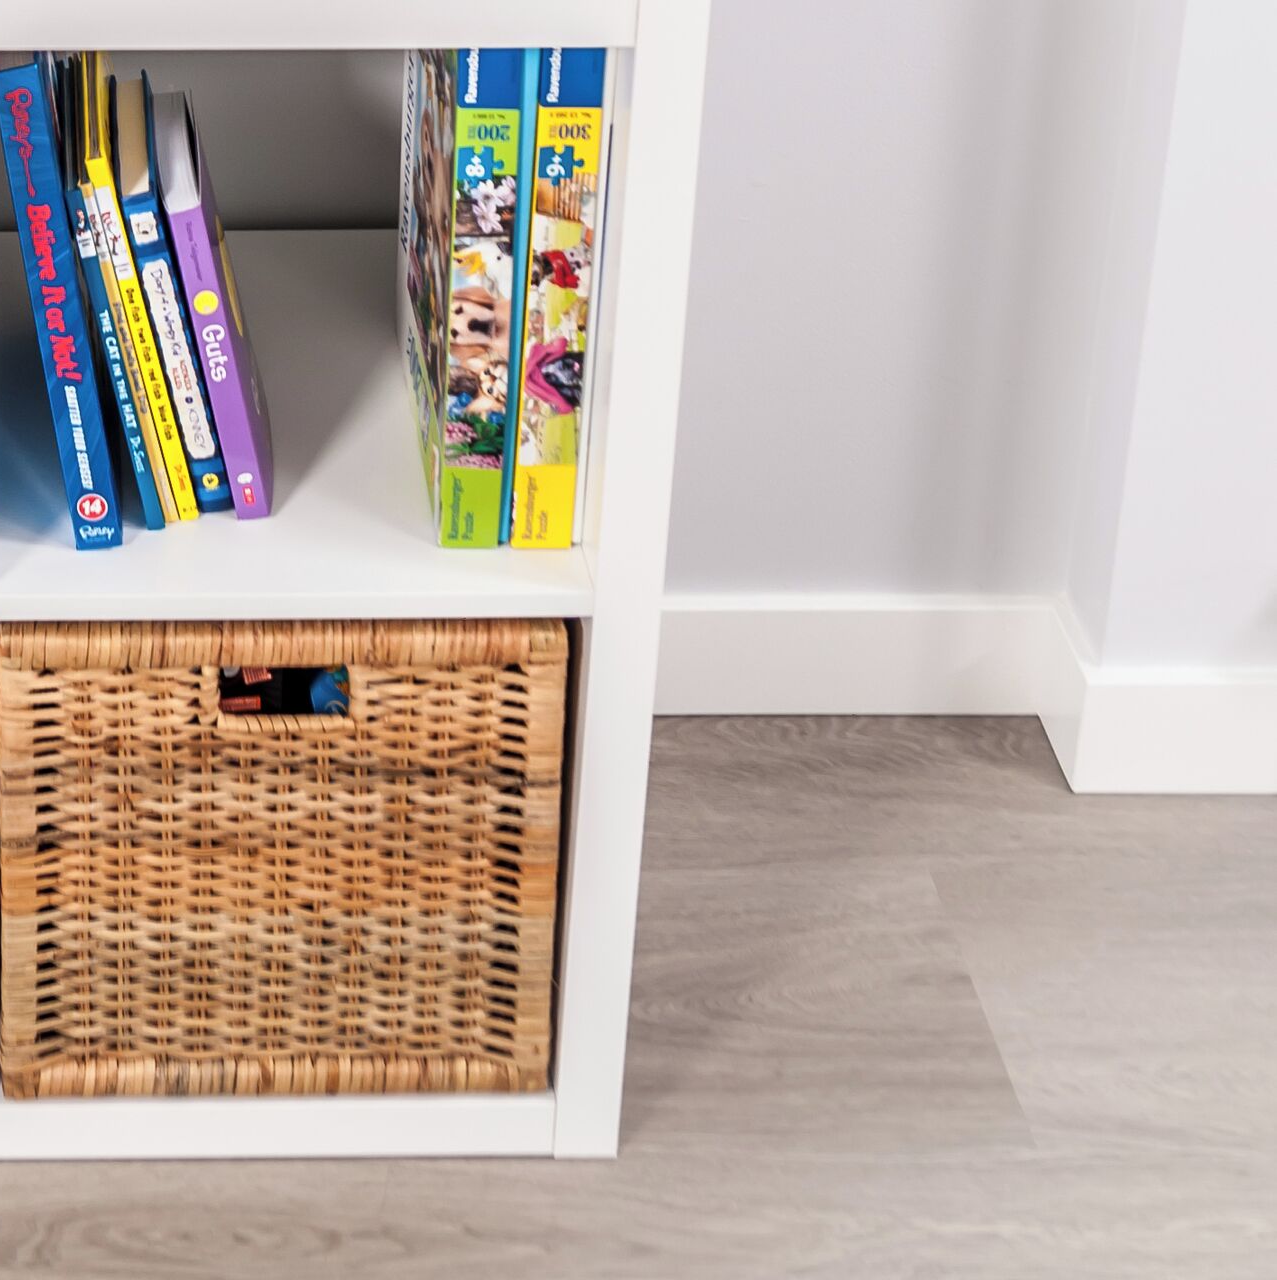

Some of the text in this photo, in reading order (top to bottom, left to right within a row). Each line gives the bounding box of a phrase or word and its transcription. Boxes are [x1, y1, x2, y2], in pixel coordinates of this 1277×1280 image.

[476, 124, 510, 141] 200
[558, 124, 592, 141] 300
[465, 155, 485, 177] 8+
[546, 154, 566, 177] 9+
[26, 203, 83, 383] Believe It or Not!
[99, 309, 113, 333] THE
[105, 336, 120, 362] CAT
[201, 324, 227, 383] Guts
[112, 362, 123, 376] IN
[125, 288, 173, 441] One fish two fish red fish blue fish
[116, 377, 129, 400] THE
[122, 401, 137, 429] HAT
[82, 499, 103, 516] 14
